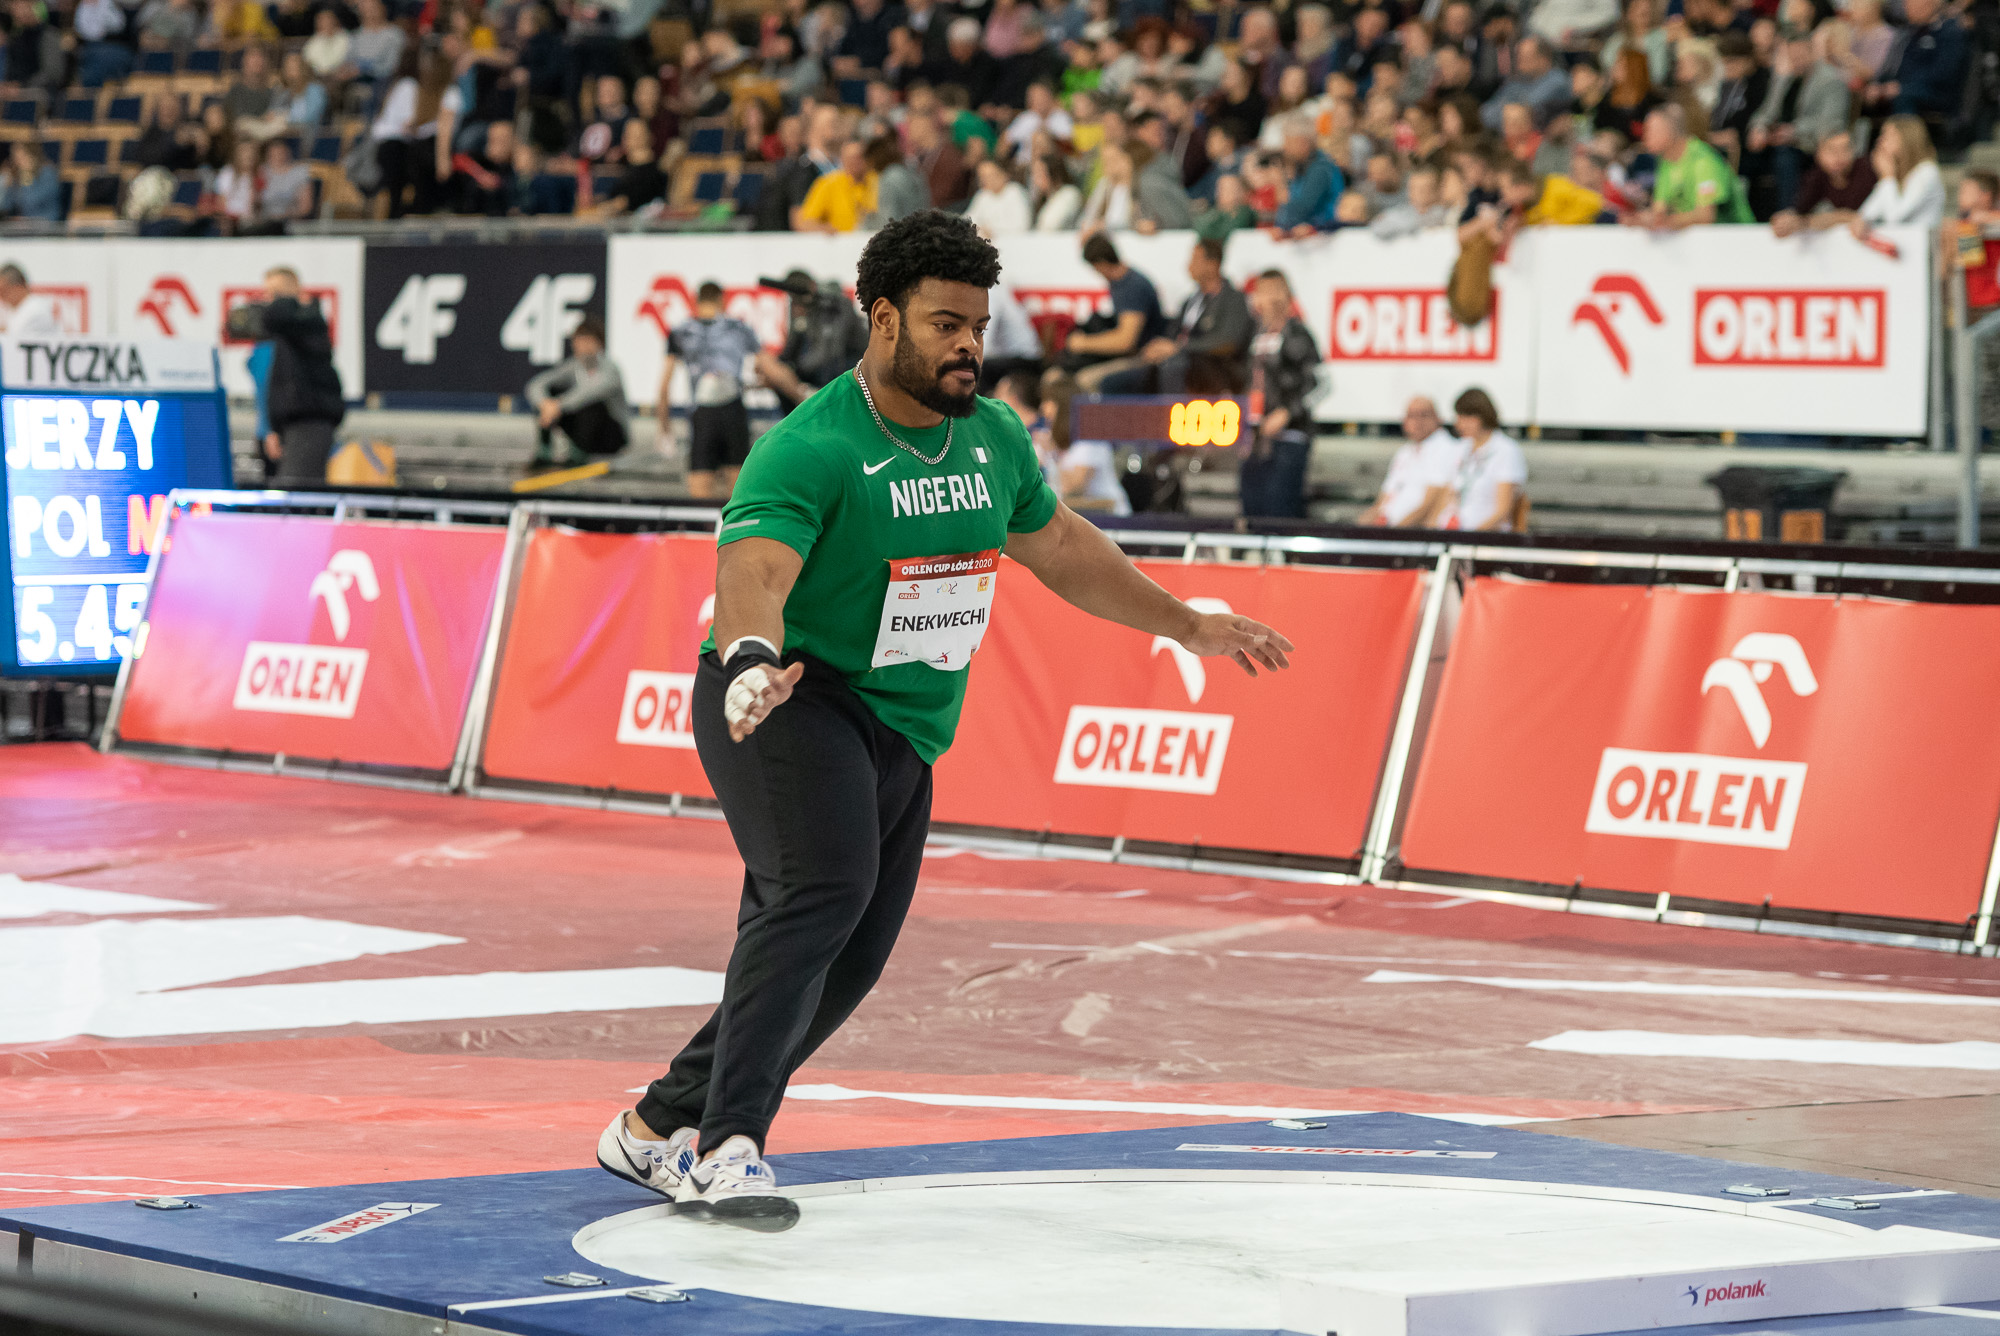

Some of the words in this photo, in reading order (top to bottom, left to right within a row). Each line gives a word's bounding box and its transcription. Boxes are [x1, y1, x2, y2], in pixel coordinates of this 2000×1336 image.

[375, 273, 468, 365] 4F
[500, 273, 597, 365] 4F
[1700, 294, 1877, 361] ORLEN
[18, 343, 147, 383] TYCZKA
[4, 399, 160, 471] JERZY
[13, 494, 111, 558] POL
[889, 473, 992, 518] NIGERIA
[901, 564, 932, 575] ORLEN
[933, 563, 950, 573] CUP
[951, 559, 974, 571] ŁÓDŹ
[974, 558, 993, 569] 2020
[17, 584, 148, 663] 5.45
[890, 607, 985, 632] ENEKWECHI
[249, 656, 354, 703] ORLEN
[1073, 720, 1215, 779] ORLEN
[1606, 765, 1788, 832] ORLEN
[1704, 1279, 1767, 1307] polanik
